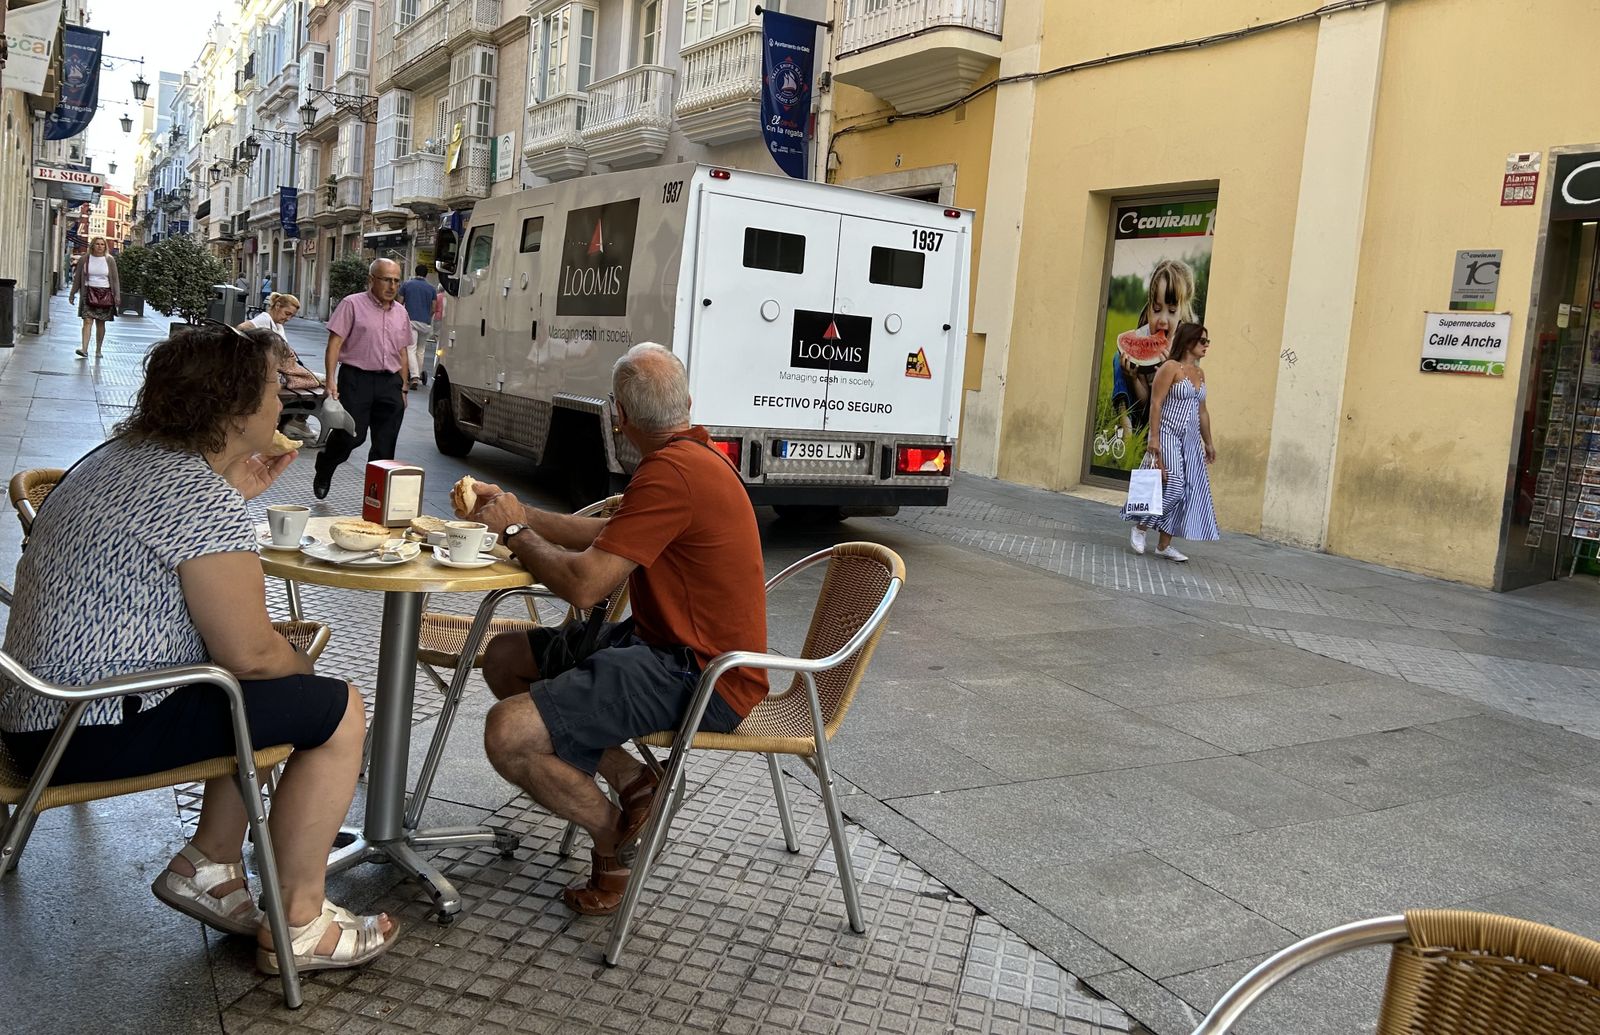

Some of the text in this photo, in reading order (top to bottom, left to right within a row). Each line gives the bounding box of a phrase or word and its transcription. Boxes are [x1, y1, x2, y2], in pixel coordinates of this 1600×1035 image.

[39, 168, 100, 185] EL SIGLO
[1506, 174, 1536, 183] Alarma
[662, 180, 684, 204] 1937
[912, 229, 944, 252] 1937
[563, 265, 623, 296] LOOMIS
[1438, 318, 1496, 328] Supermercados
[548, 324, 579, 343] Managing
[580, 326, 597, 341] cash
[599, 327, 605, 341] in
[1429, 333, 1502, 348] Calle Ancha
[798, 340, 862, 363] LOOMIS
[779, 371, 818, 384] Managing
[819, 375, 839, 384] cash
[840, 376, 847, 384] in
[753, 395, 893, 414] EFECTIVO PAGO SEGURO
[789, 442, 852, 459] 7396 LJN
[1127, 503, 1149, 512] BIMBA
